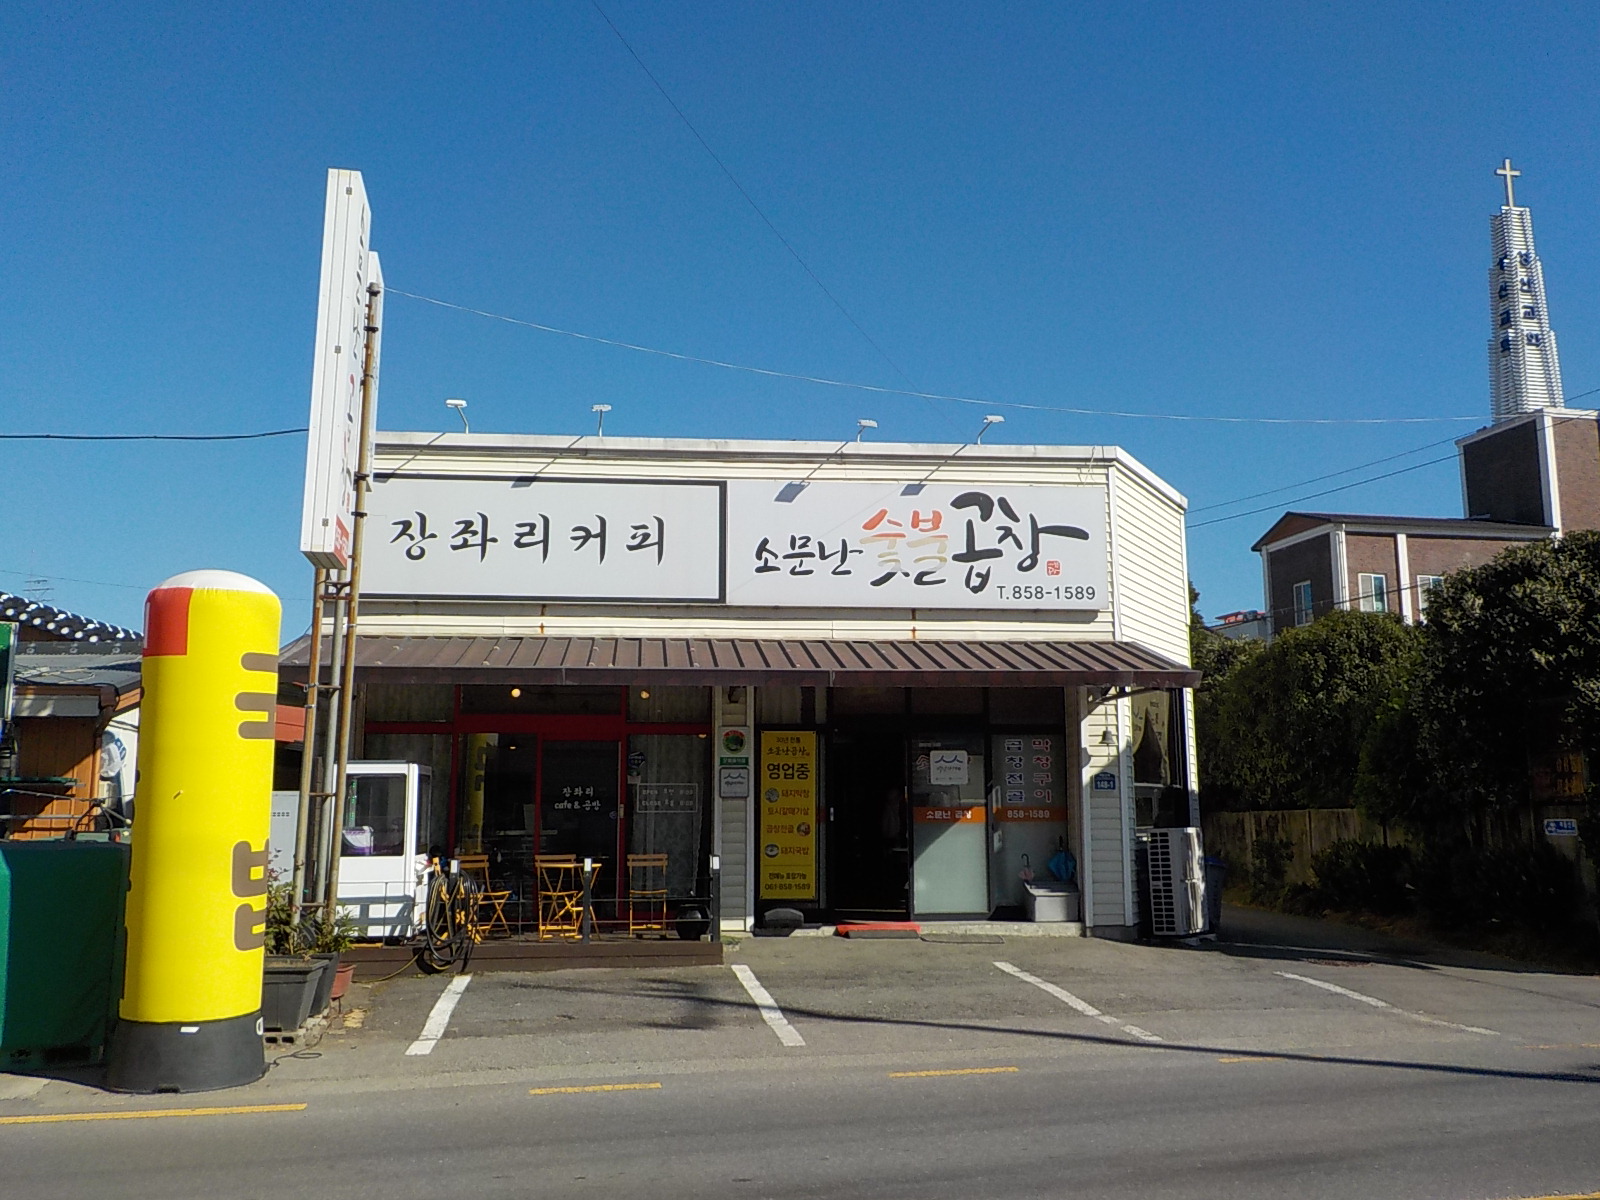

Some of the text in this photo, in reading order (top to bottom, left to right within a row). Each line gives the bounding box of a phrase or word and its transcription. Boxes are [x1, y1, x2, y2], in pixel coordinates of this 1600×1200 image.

[389, 510, 665, 566] 장좌리커피
[754, 535, 863, 576] 소문난
[949, 491, 1090, 594] 곱창
[996, 585, 1096, 600] T.858-1589
[767, 763, 810, 780] 영업중
[1032, 738, 1053, 803] 막창구이
[562, 785, 595, 798] 장좌리
[554, 800, 601, 811] cafe & 공방
[1007, 810, 1050, 820] 858-1589
